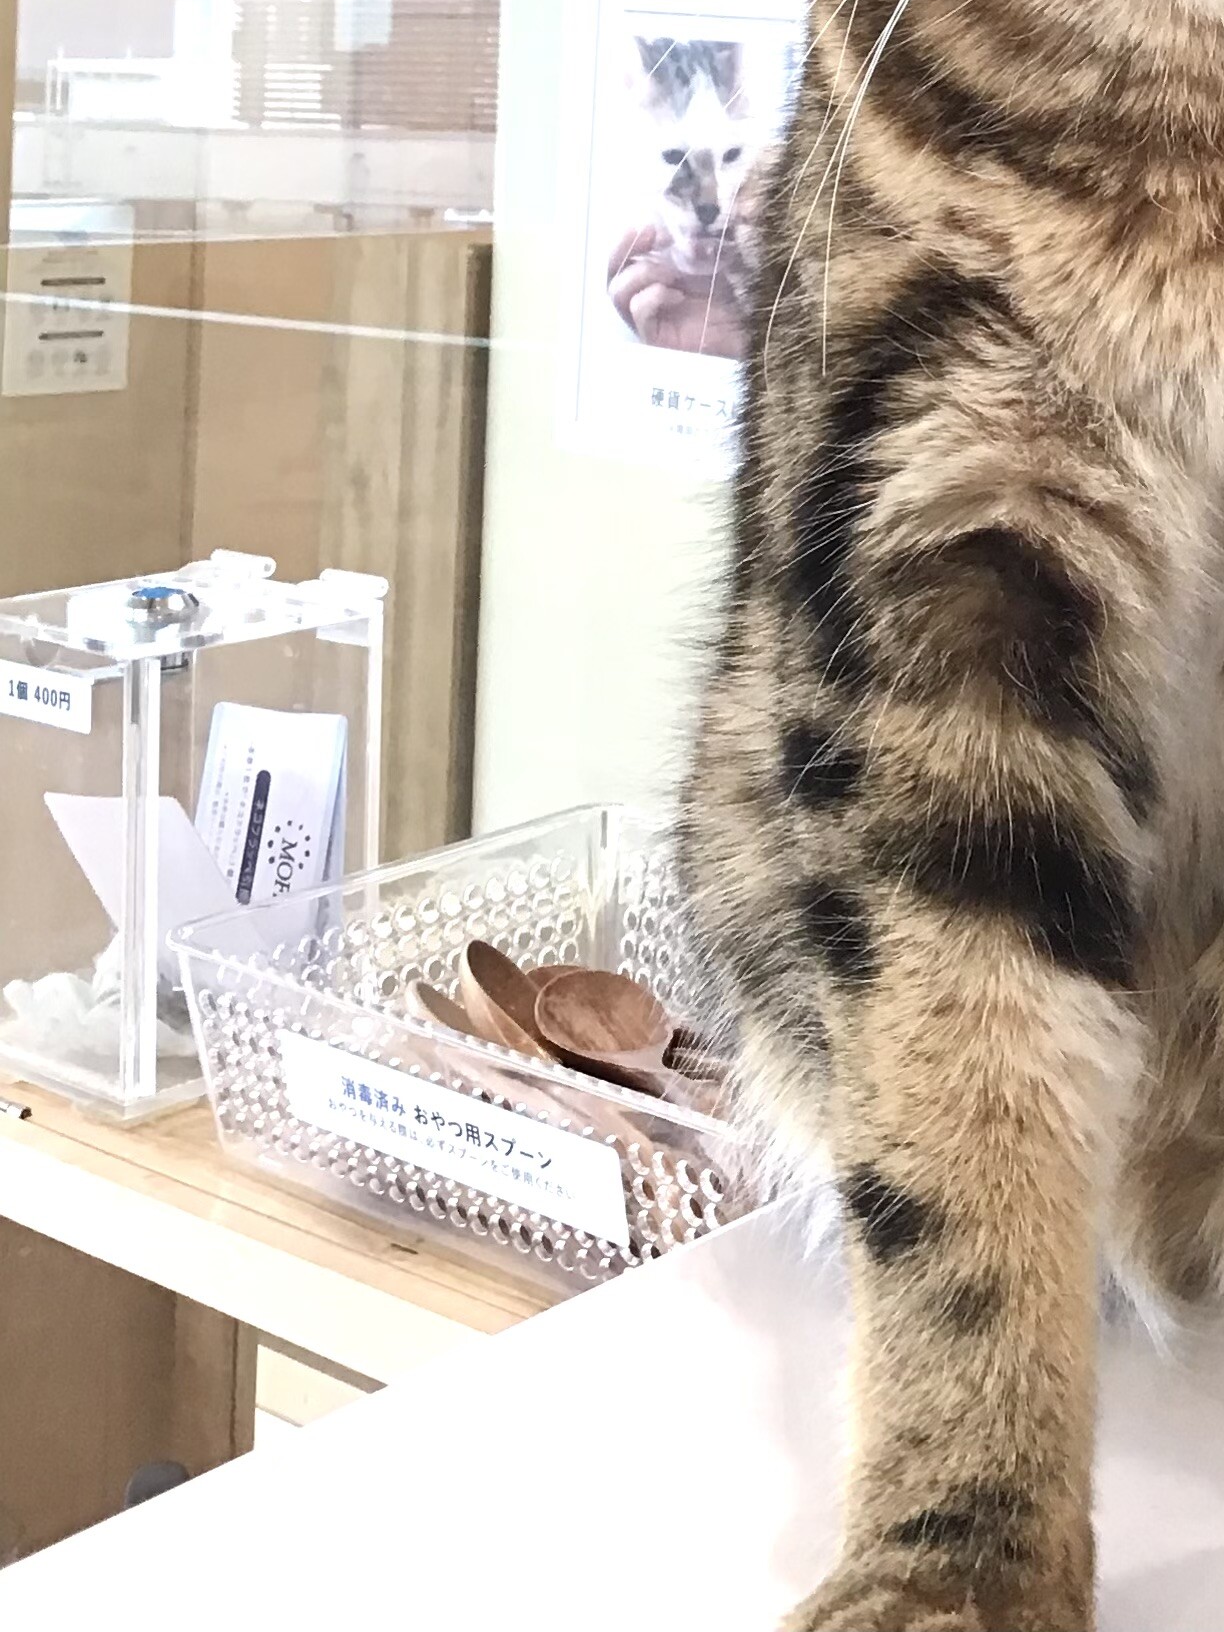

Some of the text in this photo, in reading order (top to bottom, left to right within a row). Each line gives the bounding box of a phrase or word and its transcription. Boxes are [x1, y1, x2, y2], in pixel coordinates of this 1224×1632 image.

[651, 387, 731, 418] 硬貨ケース
[34, 685, 71, 711] 400円
[272, 837, 299, 897] MOF
[341, 1075, 552, 1169] 消毒済み おやつ用スプーン
